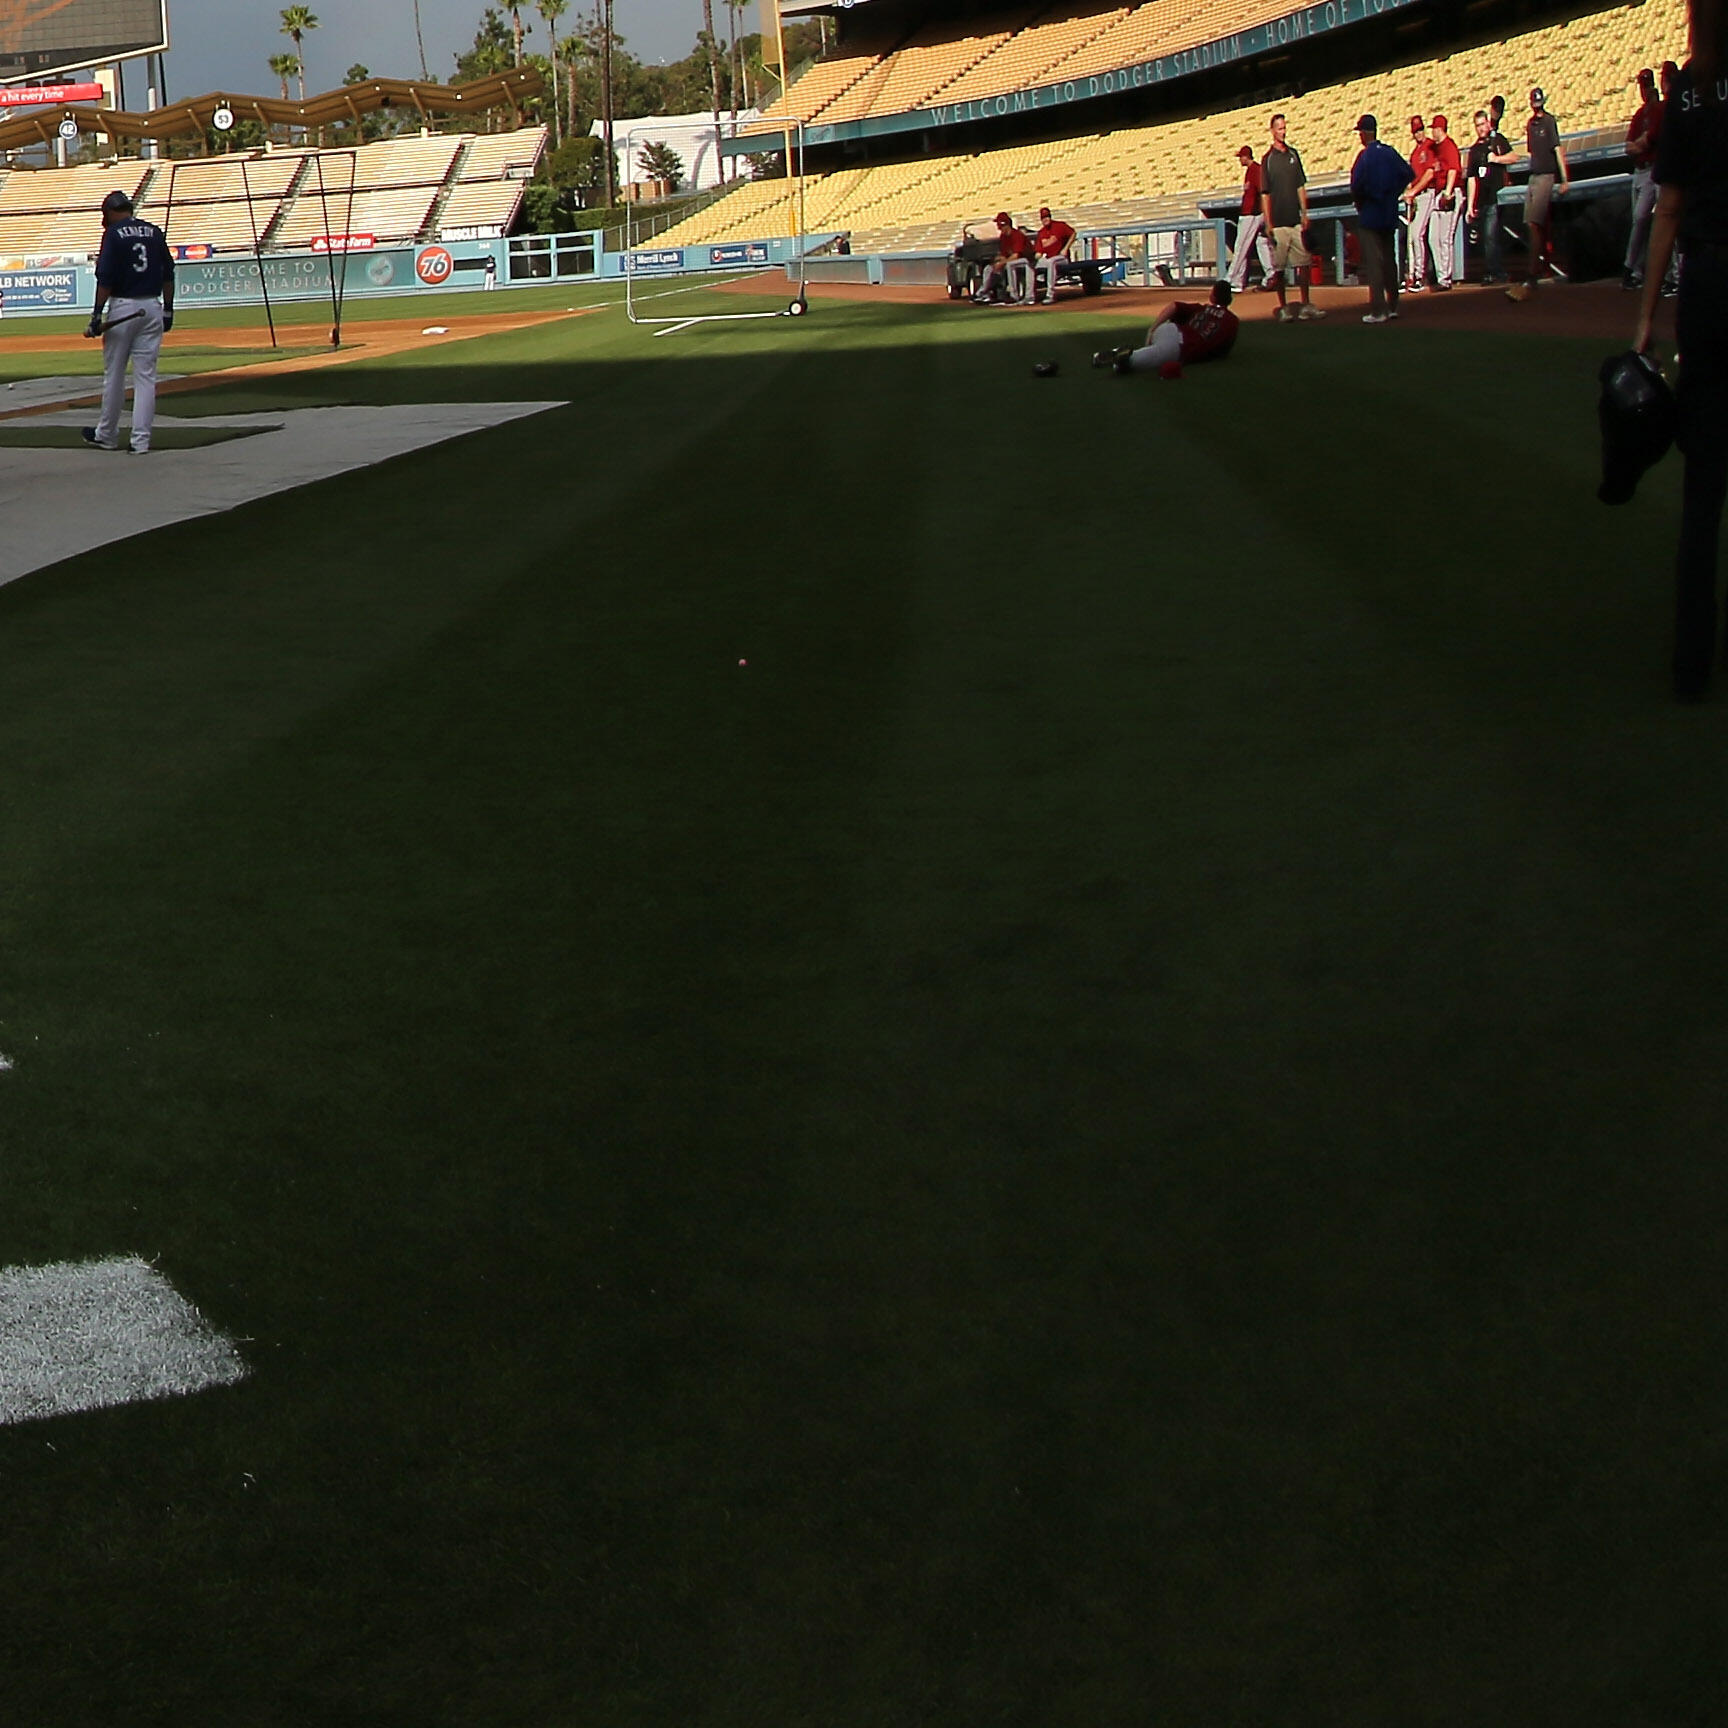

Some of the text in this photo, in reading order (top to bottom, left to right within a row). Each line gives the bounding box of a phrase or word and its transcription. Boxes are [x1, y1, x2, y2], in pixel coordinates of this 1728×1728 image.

[931, 89, 1040, 126] WELCOME
[1052, 83, 1076, 104] TO
[1089, 60, 1164, 97] DODGER
[1173, 34, 1241, 75] STADIUM
[1265, 8, 1314, 42] HOME
[7, 94, 20, 102] hit
[20, 94, 45, 104] every
[44, 90, 64, 100] time
[1681, 77, 1728, 112] SEU
[218, 114, 229, 124] 53
[61, 125, 74, 134] 42
[116, 226, 154, 239] KENNEDY
[132, 242, 149, 273] 3
[421, 253, 446, 277] 76
[201, 261, 315, 279] WELCOME TO
[14, 274, 72, 288] NETWORK
[180, 275, 338, 296] DODGER STADIUM
